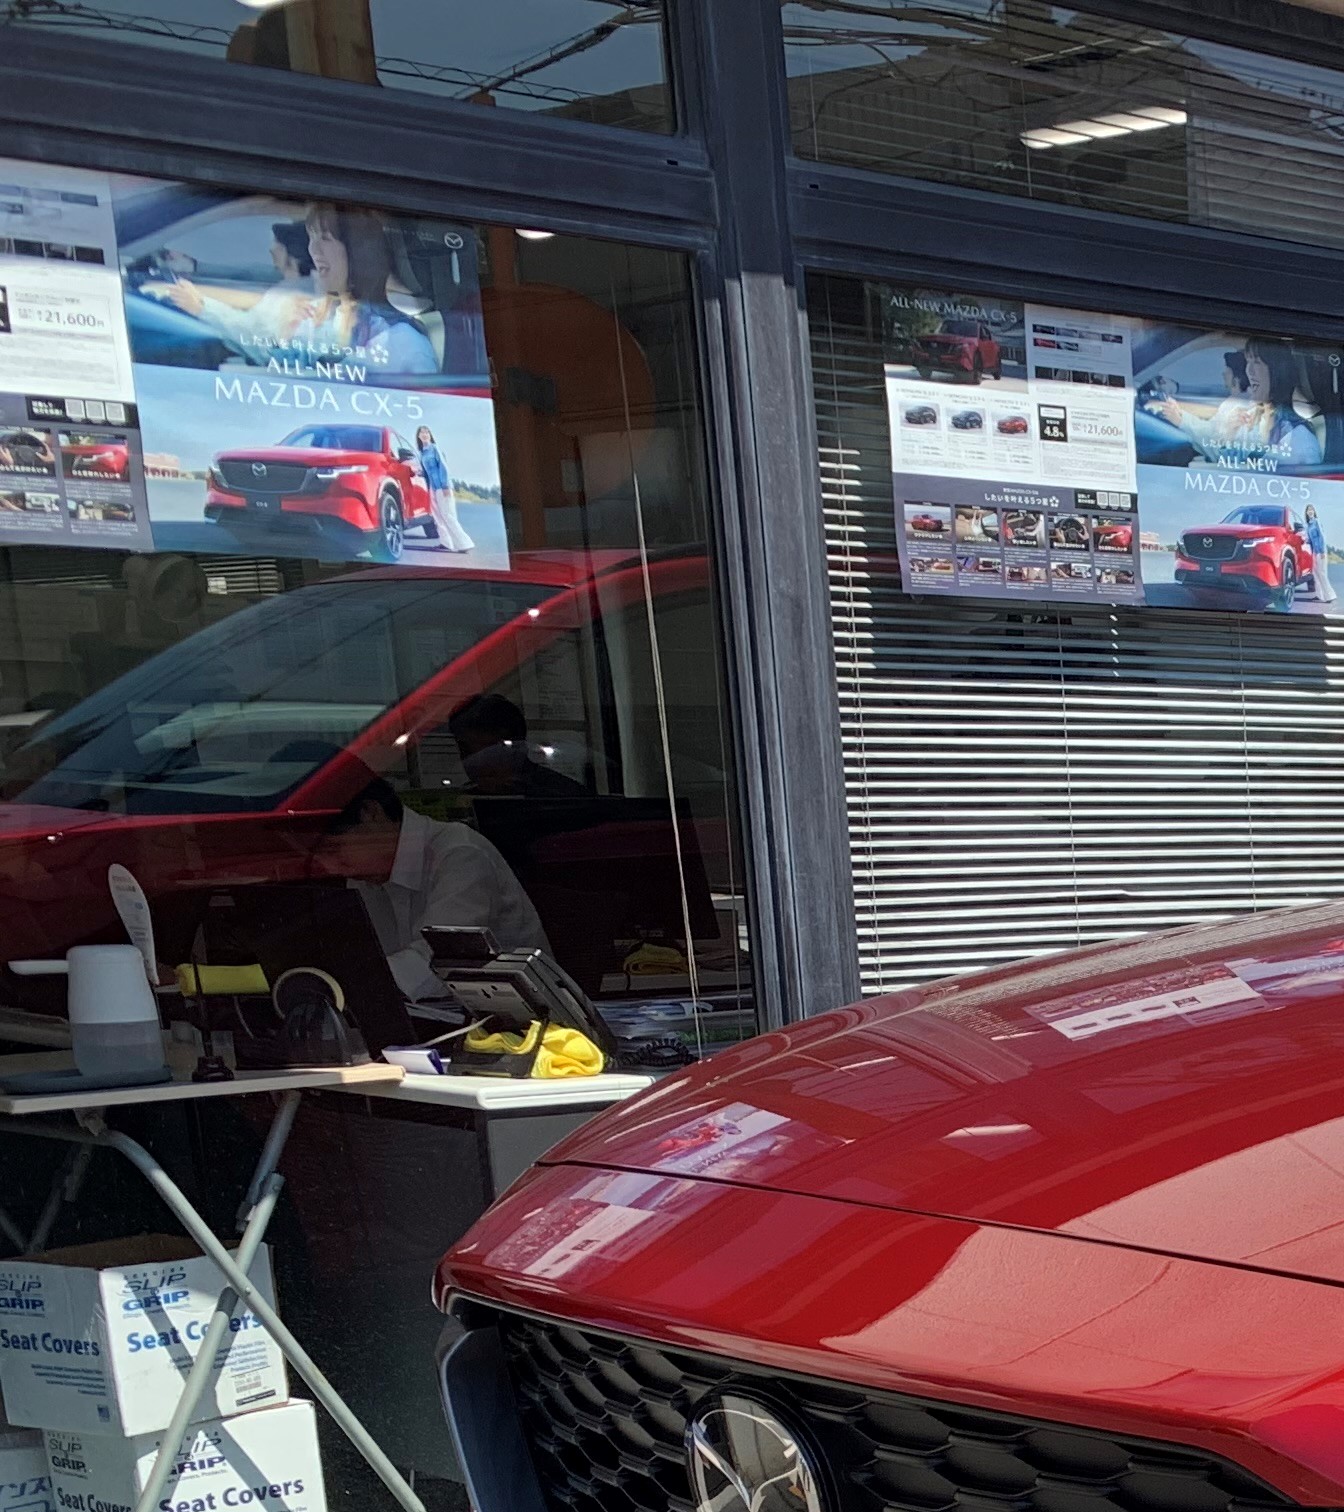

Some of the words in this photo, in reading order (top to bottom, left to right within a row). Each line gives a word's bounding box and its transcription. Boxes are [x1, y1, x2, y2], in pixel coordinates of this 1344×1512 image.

[890, 296, 940, 313] ALL-NEW
[943, 303, 988, 319] MAZDA
[266, 356, 367, 383] ALL-NEW
[215, 377, 340, 412] MAZDA
[351, 391, 423, 419] CX-5
[1217, 455, 1278, 472] ALL-NEW
[1184, 472, 1261, 496] MAZDA
[1267, 479, 1311, 499] CX-5
[123, 1273, 187, 1293] SLIP
[122, 1290, 189, 1312] GRIP
[0, 1328, 38, 1350] Seat
[41, 1332, 100, 1357] Covers
[127, 1327, 181, 1353] Seat
[186, 1312, 263, 1340] Coers
[49, 1438, 82, 1453] SLIP
[177, 1438, 222, 1456] LIP
[51, 1455, 86, 1470] GRIP
[170, 1456, 226, 1475] RIP
[57, 1487, 85, 1511] Seat
[222, 1479, 305, 1506] Covers
